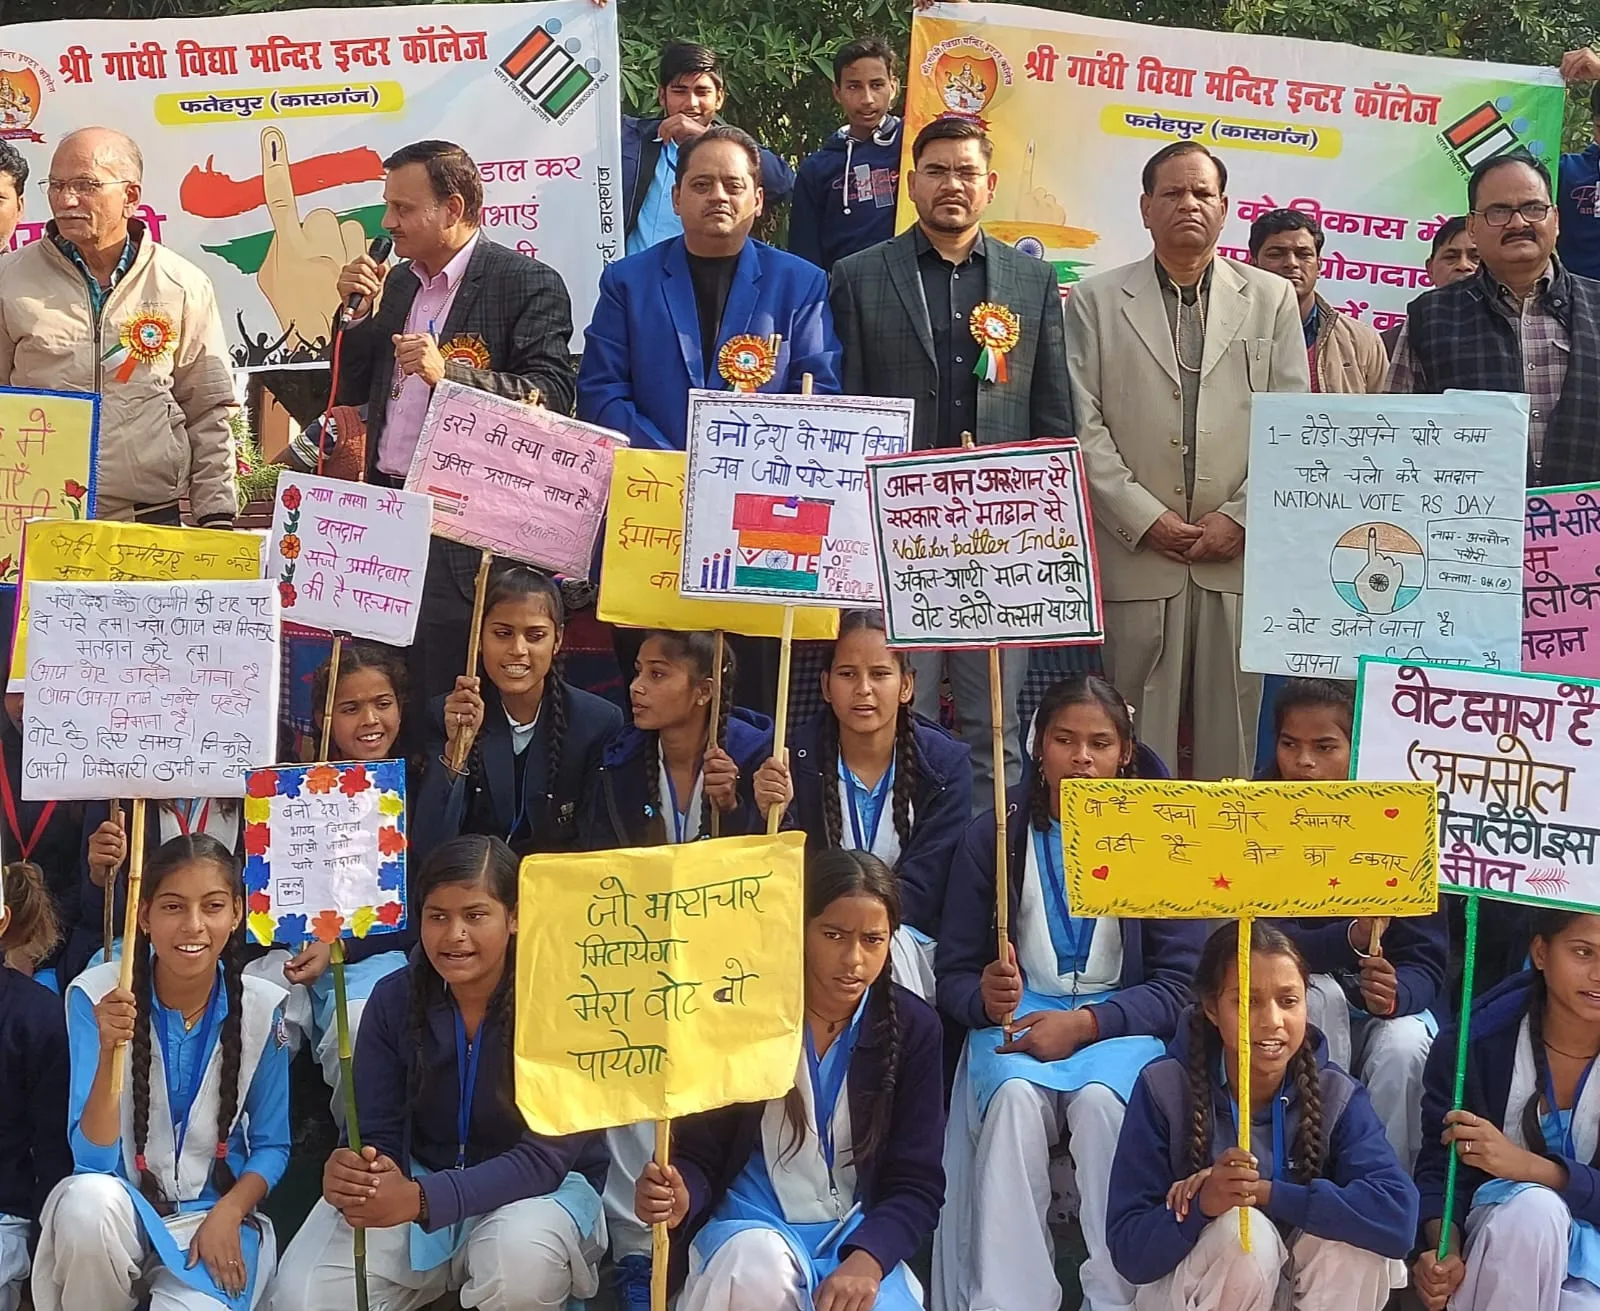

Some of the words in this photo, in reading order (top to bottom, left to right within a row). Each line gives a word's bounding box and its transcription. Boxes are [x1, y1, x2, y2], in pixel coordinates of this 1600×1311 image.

[59, 45, 92, 84] श्री
[102, 41, 167, 81] गांधी
[176, 39, 237, 77] विद्या
[246, 35, 321, 72] मन्दिर
[330, 36, 390, 73] इन्टर
[398, 25, 488, 64] कॉलेज
[180, 95, 262, 117] फतेहपुर
[271, 85, 379, 112] (कासगंज)
[1024, 45, 1059, 81] श्री
[1067, 50, 1129, 90] गांधी
[1137, 55, 1197, 98] विद्या
[1204, 66, 1278, 107] मन्दिर
[1286, 79, 1345, 114] इन्टर
[1353, 82, 1442, 125] कॉलेज
[1125, 113, 1206, 139] फतेहपुर
[1211, 118, 1318, 150] (कासगंज)
[477, 160, 528, 182] डाल
[534, 156, 583, 179] कर
[593, 166, 613, 235] कासगंज
[443, 413, 477, 436] डरने
[485, 424, 508, 447] की
[512, 437, 544, 460] क्या
[552, 449, 579, 468] बात
[580, 450, 597, 474] है
[1339, 414, 1399, 447] अपने
[1410, 420, 1443, 446] सारे
[1454, 425, 1492, 443] काम
[433, 451, 475, 476] पुलिस
[484, 467, 535, 492] प्रशासन
[544, 484, 576, 505] साथ
[627, 467, 673, 502] जो
[1048, 456, 1071, 489] से
[1295, 460, 1331, 484] पहले
[1433, 469, 1484, 484] मतदान
[376, 490, 406, 520] और
[883, 506, 942, 529] सरकार
[944, 497, 971, 528] बने
[974, 500, 1039, 525] मतदान
[1039, 489, 1068, 523] से
[1274, 490, 1352, 510] NATIONAL
[1360, 494, 1405, 512] VOTE
[1422, 495, 1442, 514] RS
[1455, 495, 1495, 514] DAY
[824, 538, 870, 556] VOICE
[893, 534, 928, 560] Vote
[1011, 526, 1078, 554] India
[823, 566, 849, 580] THE
[832, 555, 852, 567] OF
[990, 562, 1034, 588] मान
[1038, 551, 1086, 586] जाओ
[301, 571, 324, 600] की
[333, 574, 349, 608] है
[827, 579, 874, 594] PEOPLE
[911, 593, 943, 631] वोट
[997, 602, 1045, 627] कसम
[1042, 586, 1089, 623] खाओ
[1287, 609, 1321, 635] वोट
[1330, 613, 1376, 637] डालने
[1379, 620, 1426, 639] जाना
[75, 640, 135, 660] मतदान
[1285, 653, 1342, 674] अपना
[1392, 666, 1457, 728] वोट
[587, 876, 636, 927] जो
[566, 974, 636, 1026] मेरा
[644, 971, 703, 1021] वोट
